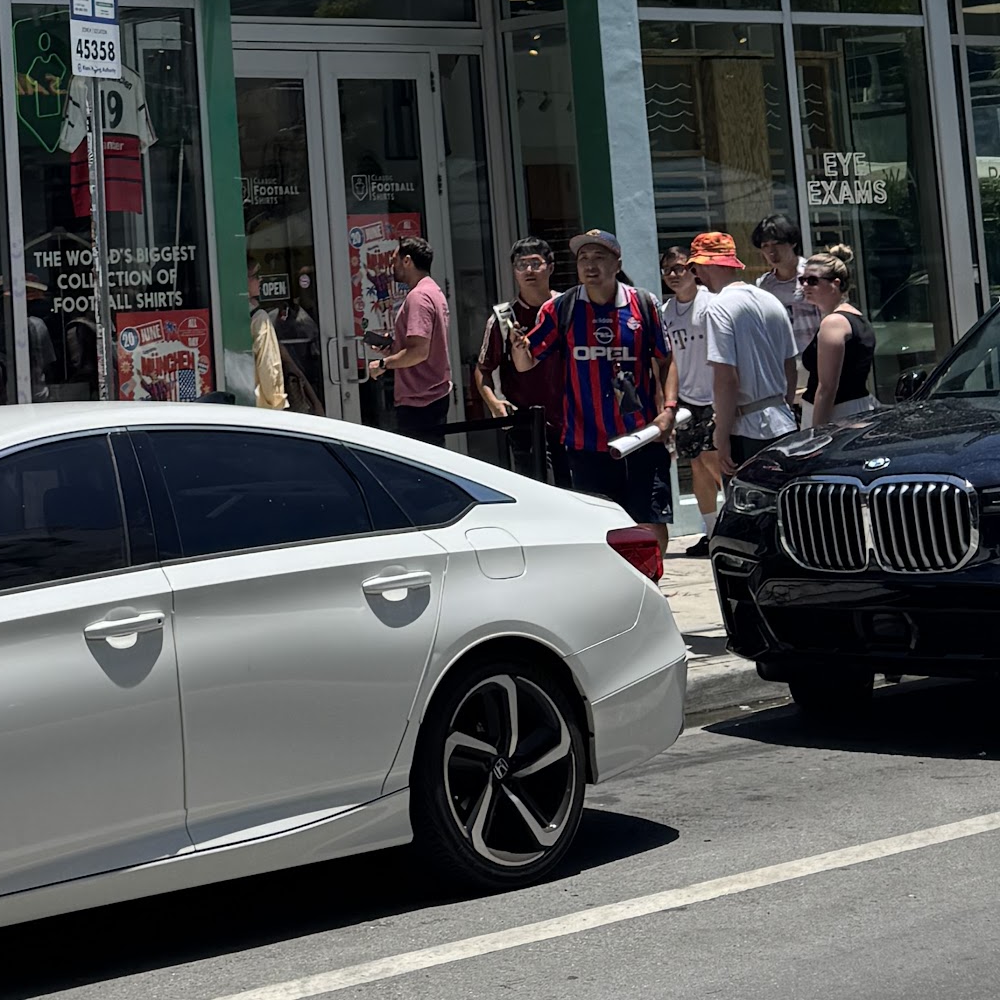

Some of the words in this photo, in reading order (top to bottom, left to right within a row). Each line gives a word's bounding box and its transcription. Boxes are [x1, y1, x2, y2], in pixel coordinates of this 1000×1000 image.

[76, 38, 116, 62] 45358
[823, 152, 867, 177] EYE
[254, 185, 300, 196] FOOTBALL
[371, 182, 415, 192] FOOTBALL
[807, 179, 888, 206] EXAMS
[33, 251, 62, 268] THE
[65, 248, 133, 266] WOD'S
[136, 245, 197, 263] BIGGEST
[56, 270, 153, 290] COLLCTION
[156, 268, 177, 285] OF
[262, 281, 287, 297] OPEN
[53, 295, 133, 314] FOOTALL
[136, 291, 184, 309] SHIRTS
[122, 332, 135, 348] 20
[140, 324, 162, 343] JUNE
[573, 346, 638, 362] OPEL
